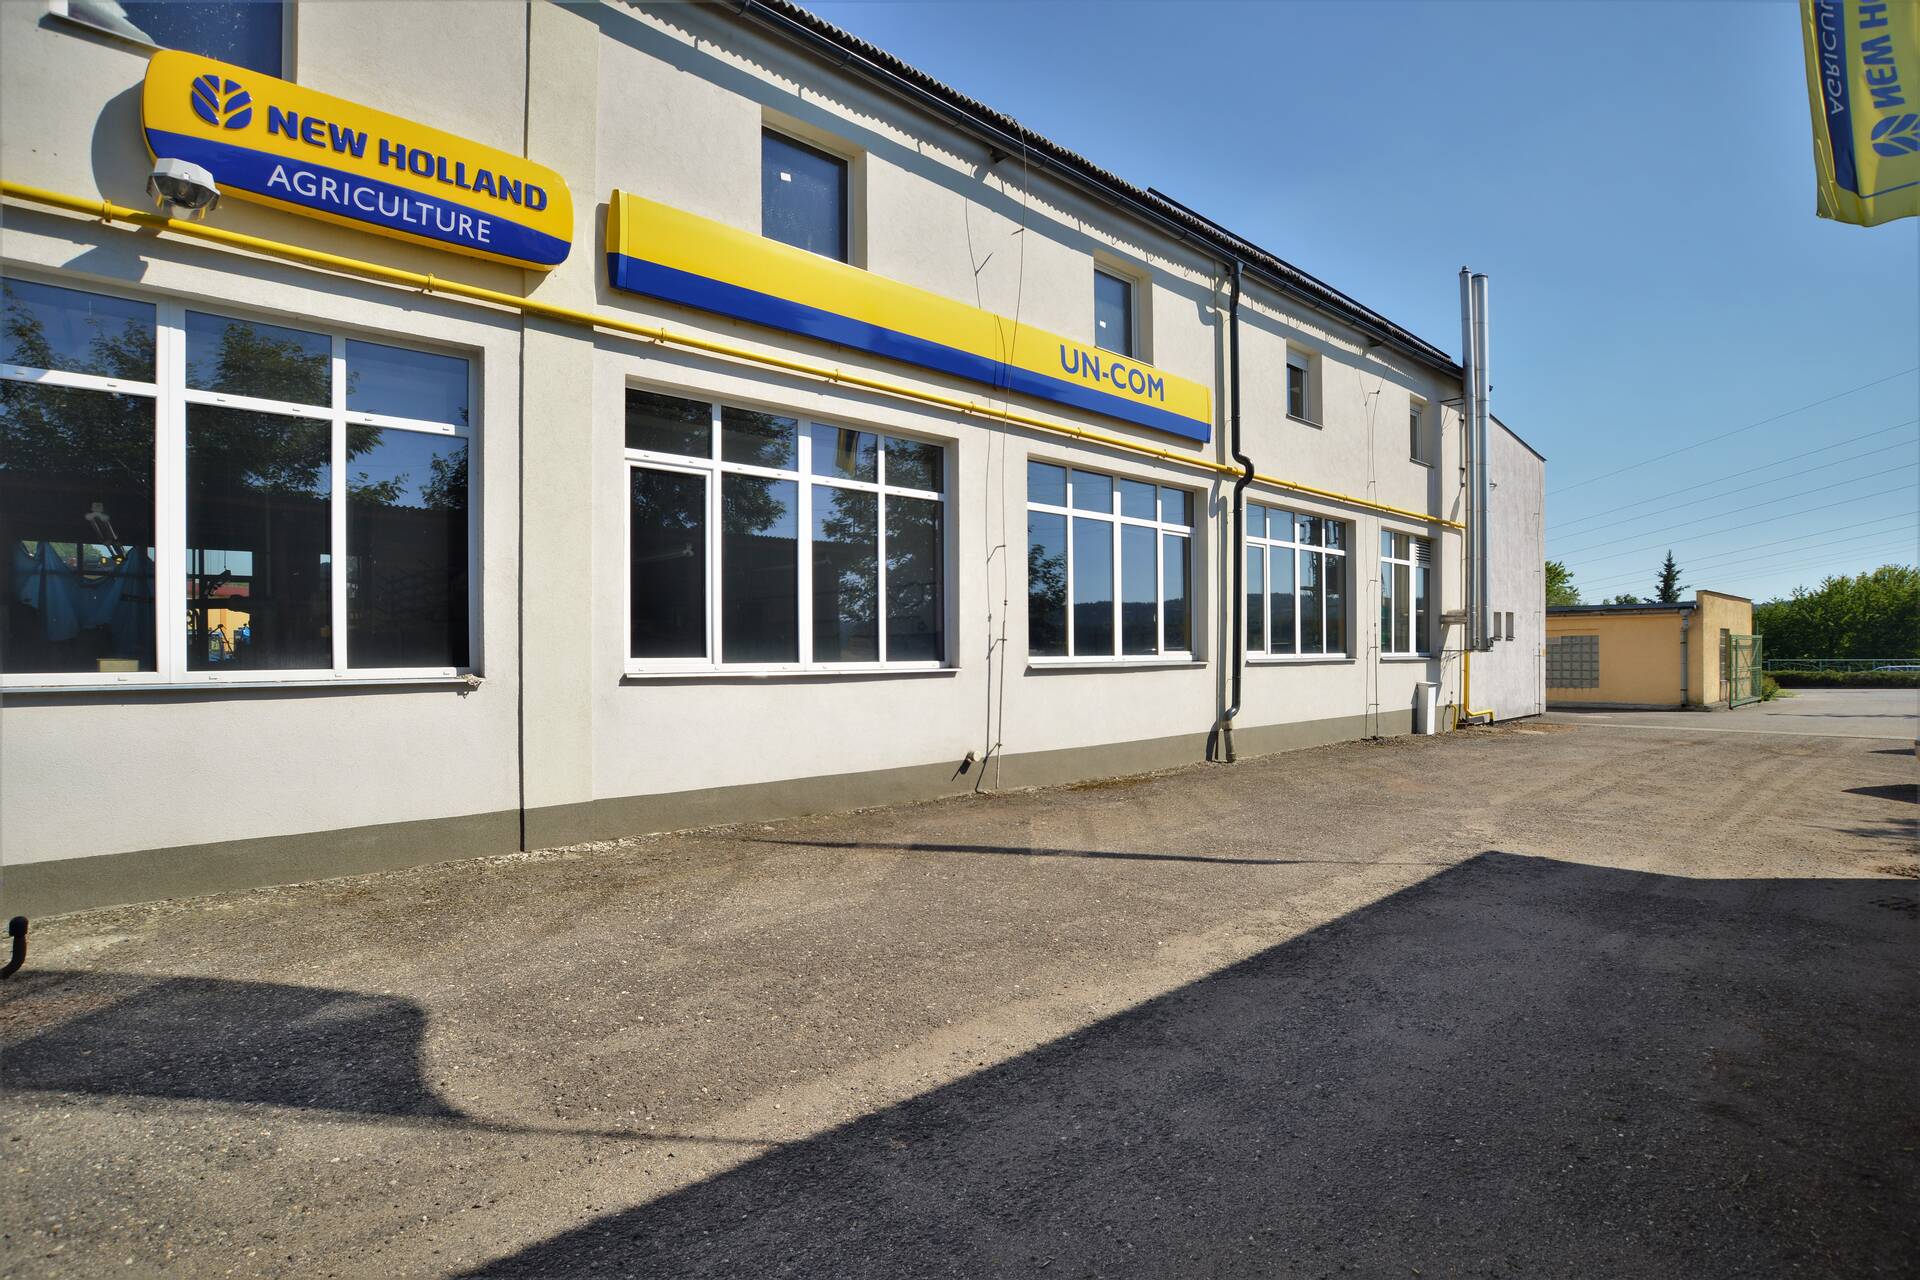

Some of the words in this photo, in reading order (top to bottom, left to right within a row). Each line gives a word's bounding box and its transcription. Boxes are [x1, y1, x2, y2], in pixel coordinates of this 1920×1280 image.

[268, 105, 368, 158] NEW
[378, 137, 548, 211] HOLLAND
[267, 165, 491, 244] AGRICULTURE
[1060, 344, 1165, 402] UN-COM
